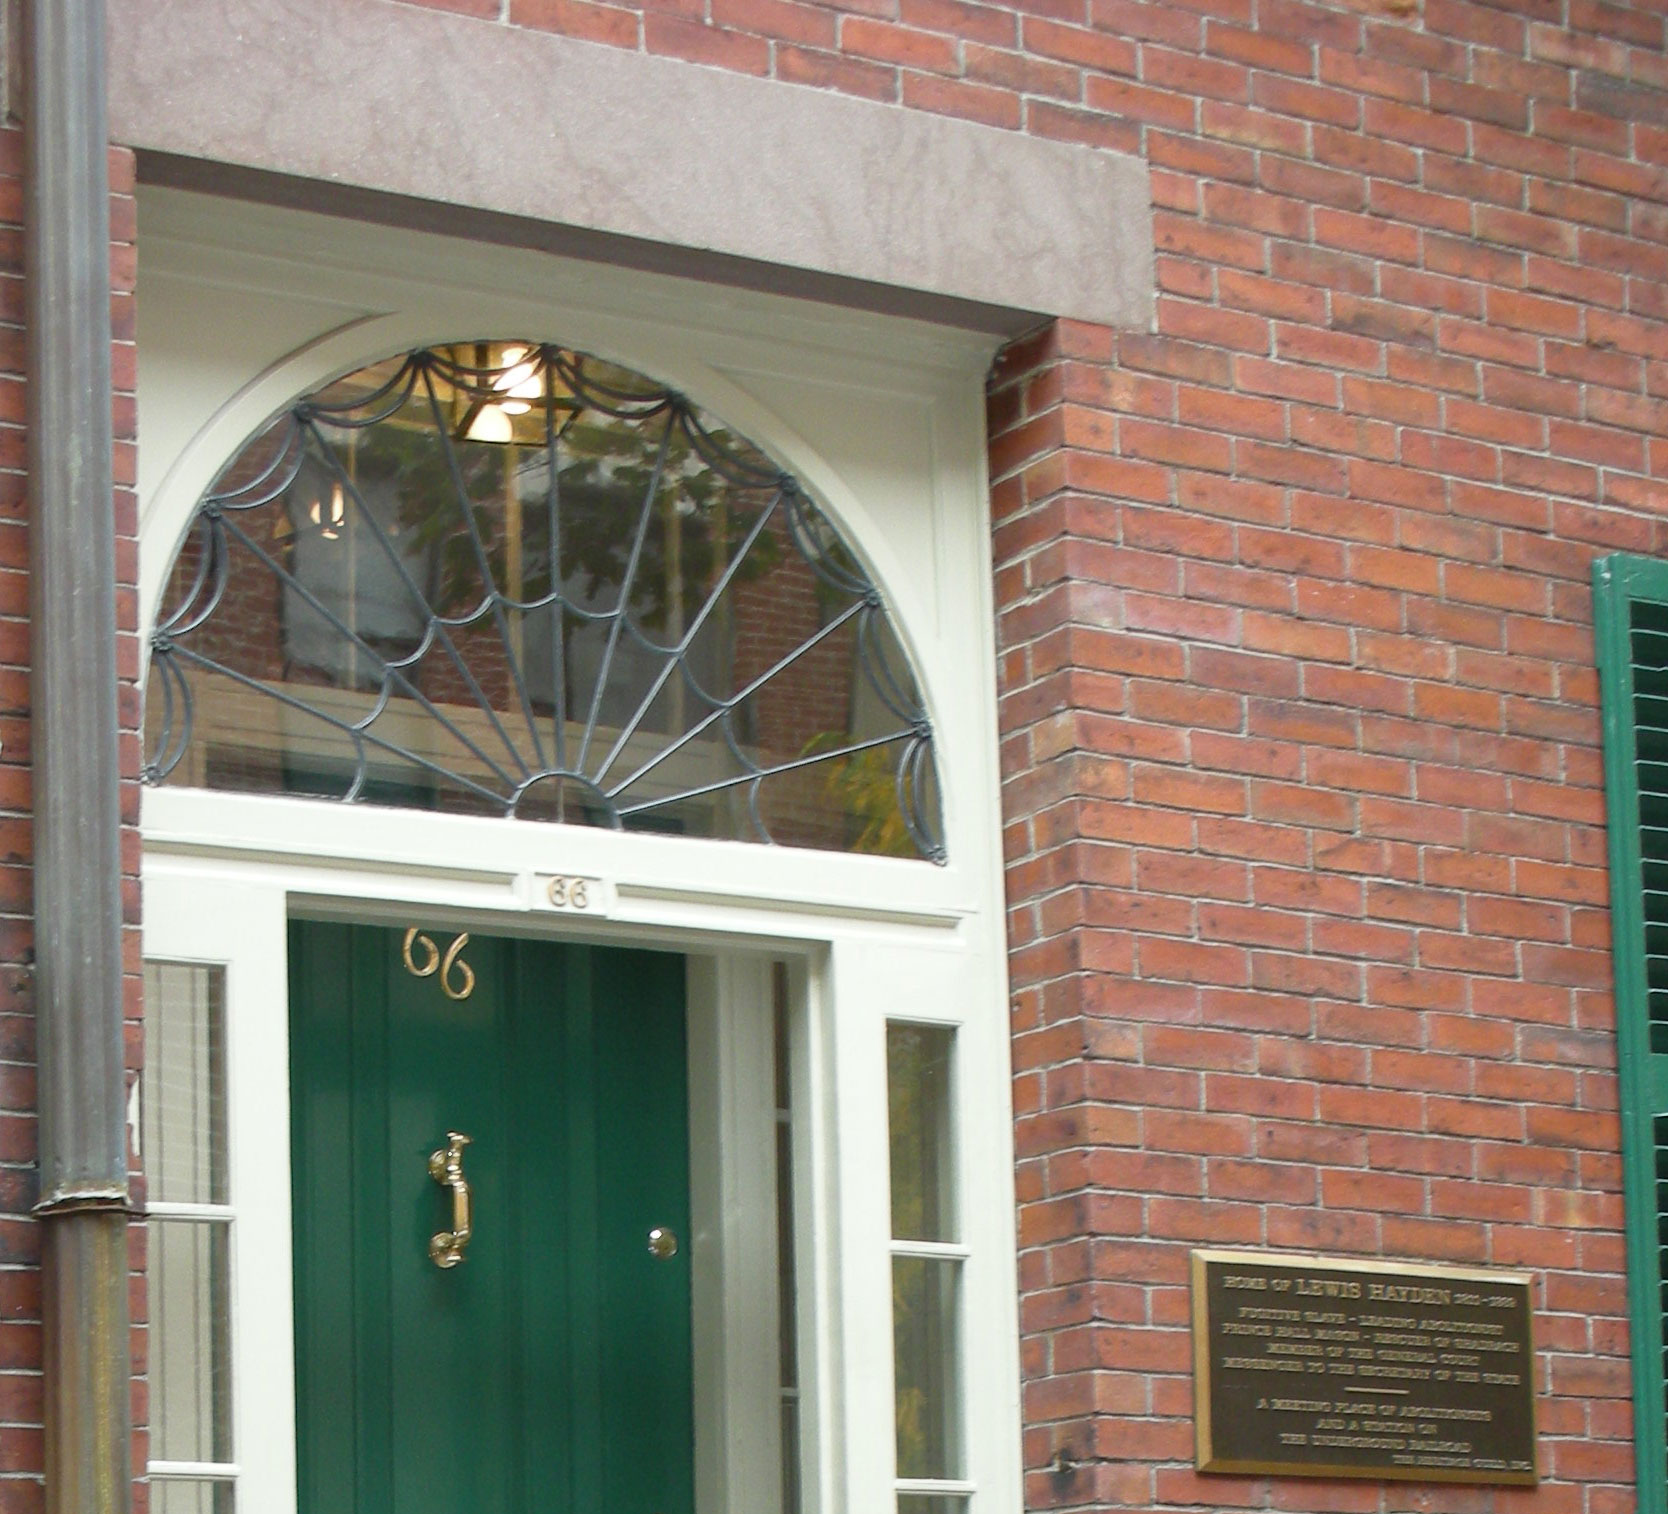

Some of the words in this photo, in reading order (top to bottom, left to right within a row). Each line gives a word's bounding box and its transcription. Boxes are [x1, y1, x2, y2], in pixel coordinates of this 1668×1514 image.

[548, 875, 588, 909] 66
[402, 927, 476, 1001] 66
[1271, 1278, 1292, 1292] OF
[1295, 1278, 1361, 1299] LEWIS
[1368, 1283, 1451, 1305] HAYDEN
